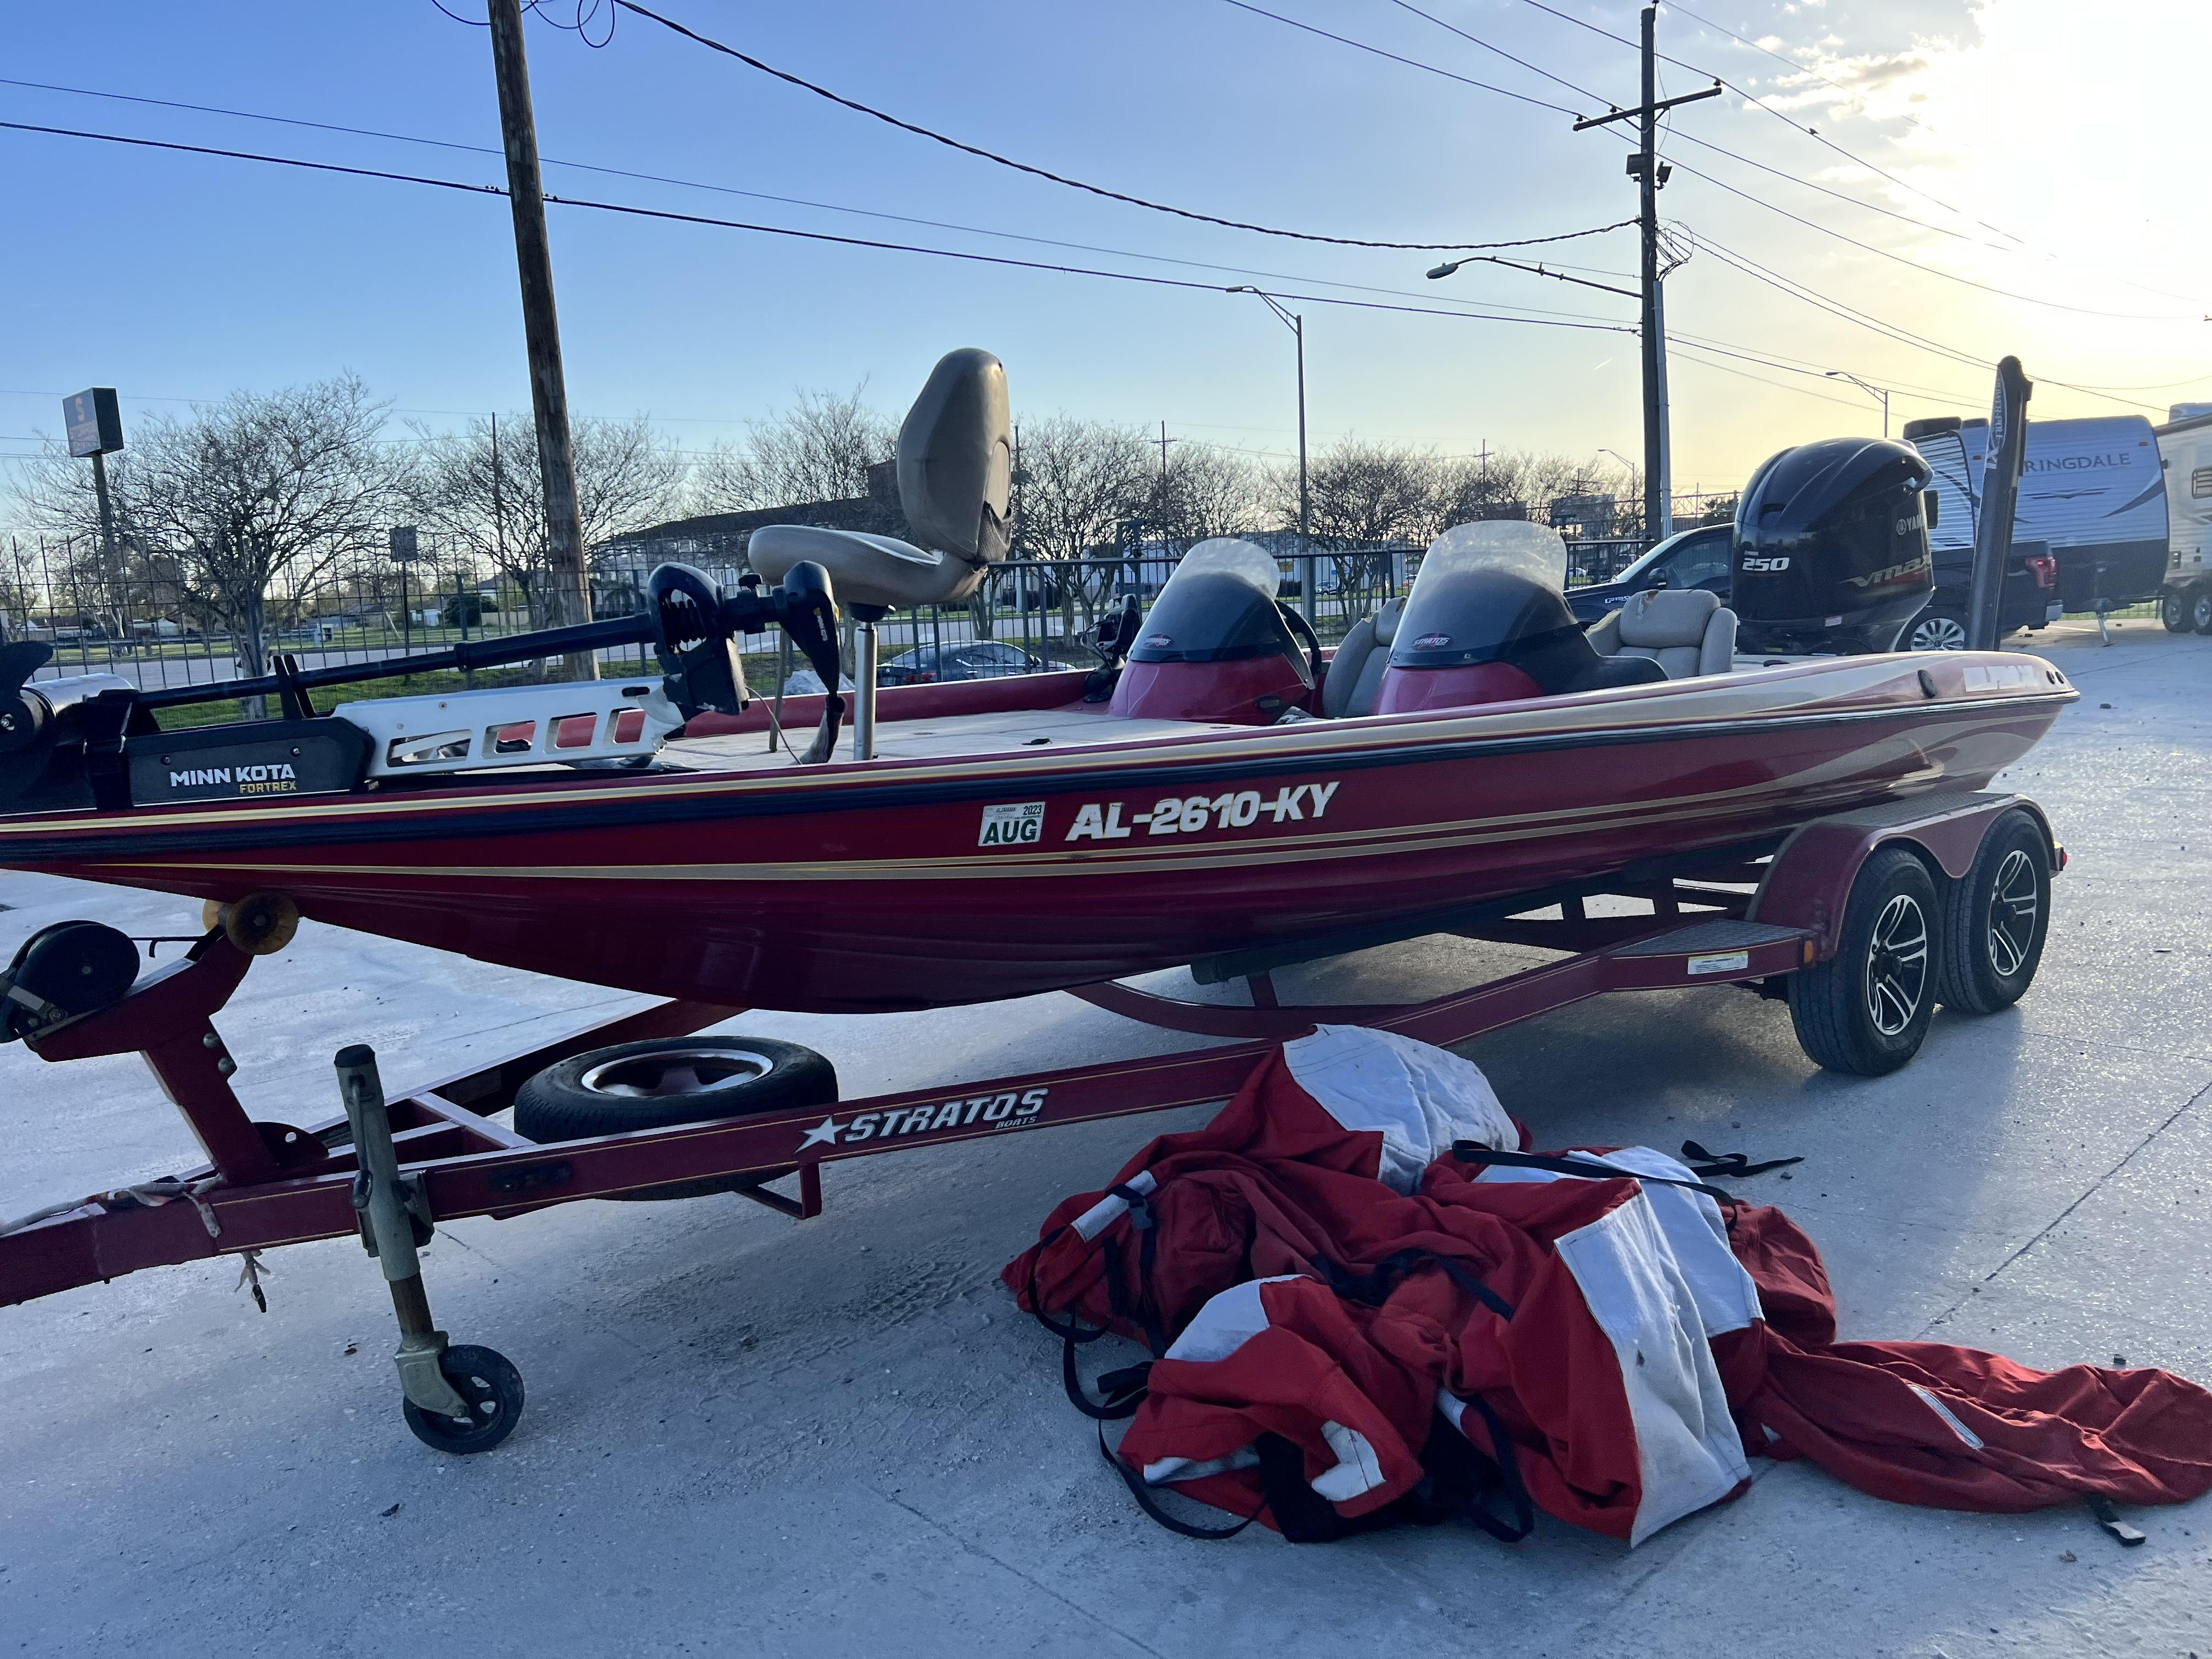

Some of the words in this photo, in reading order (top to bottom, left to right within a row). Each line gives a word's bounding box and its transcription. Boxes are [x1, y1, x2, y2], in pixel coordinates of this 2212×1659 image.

[2025, 453, 2131, 472] RINGDALE
[1742, 557, 1790, 571] 250
[1412, 637, 1450, 646] STRATOS
[170, 768, 231, 787] MINN
[235, 764, 296, 782] KOTA
[239, 781, 297, 794] FORTREX
[1023, 805, 1042, 816] 2023
[1064, 781, 1340, 841] AL-2610-KY
[983, 819, 1037, 844] AUG
[844, 1088, 1048, 1142] STRATOS
[995, 1116, 1037, 1130] BOATS
